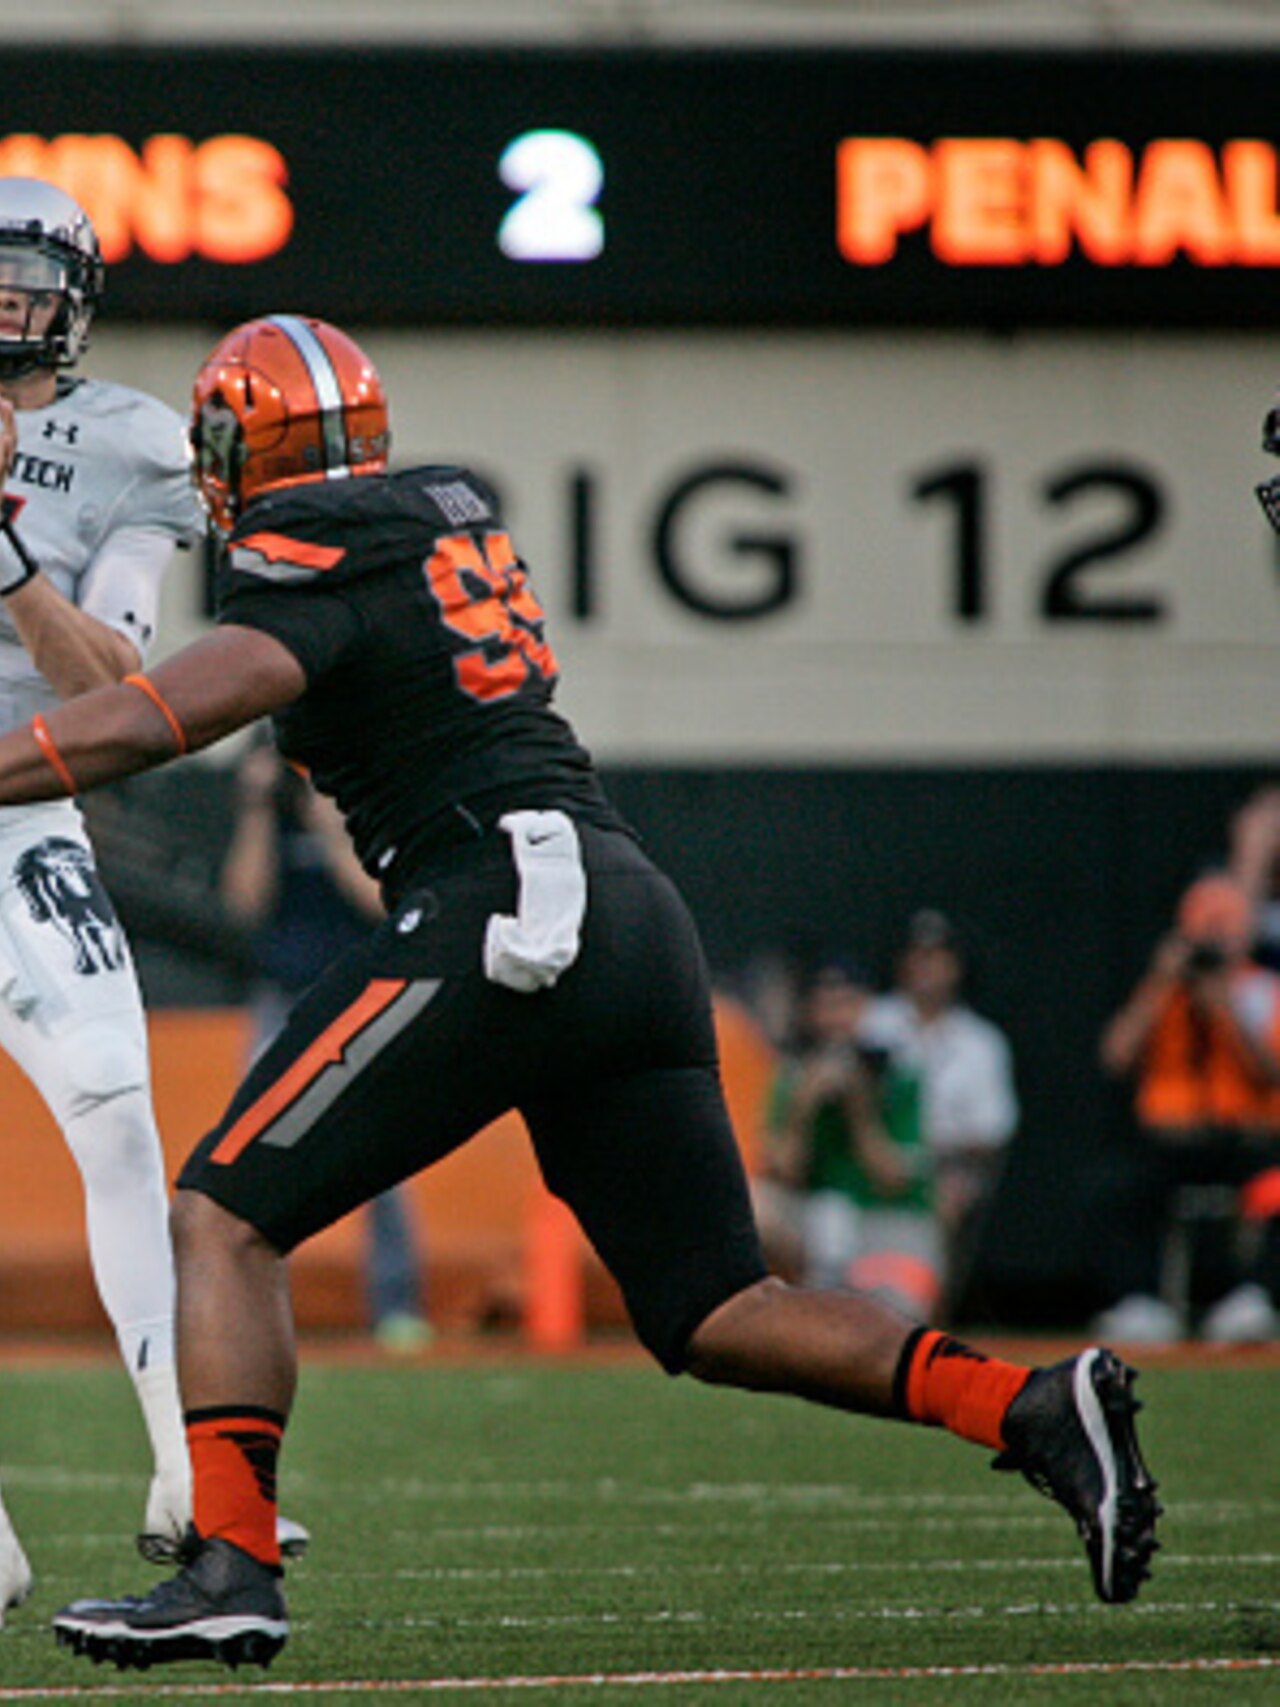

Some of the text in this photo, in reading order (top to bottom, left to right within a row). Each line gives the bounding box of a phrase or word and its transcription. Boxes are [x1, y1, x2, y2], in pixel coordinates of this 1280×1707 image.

[499, 130, 604, 261] 2
[835, 137, 1280, 266] PENAL
[494, 458, 1167, 622] IG 12
